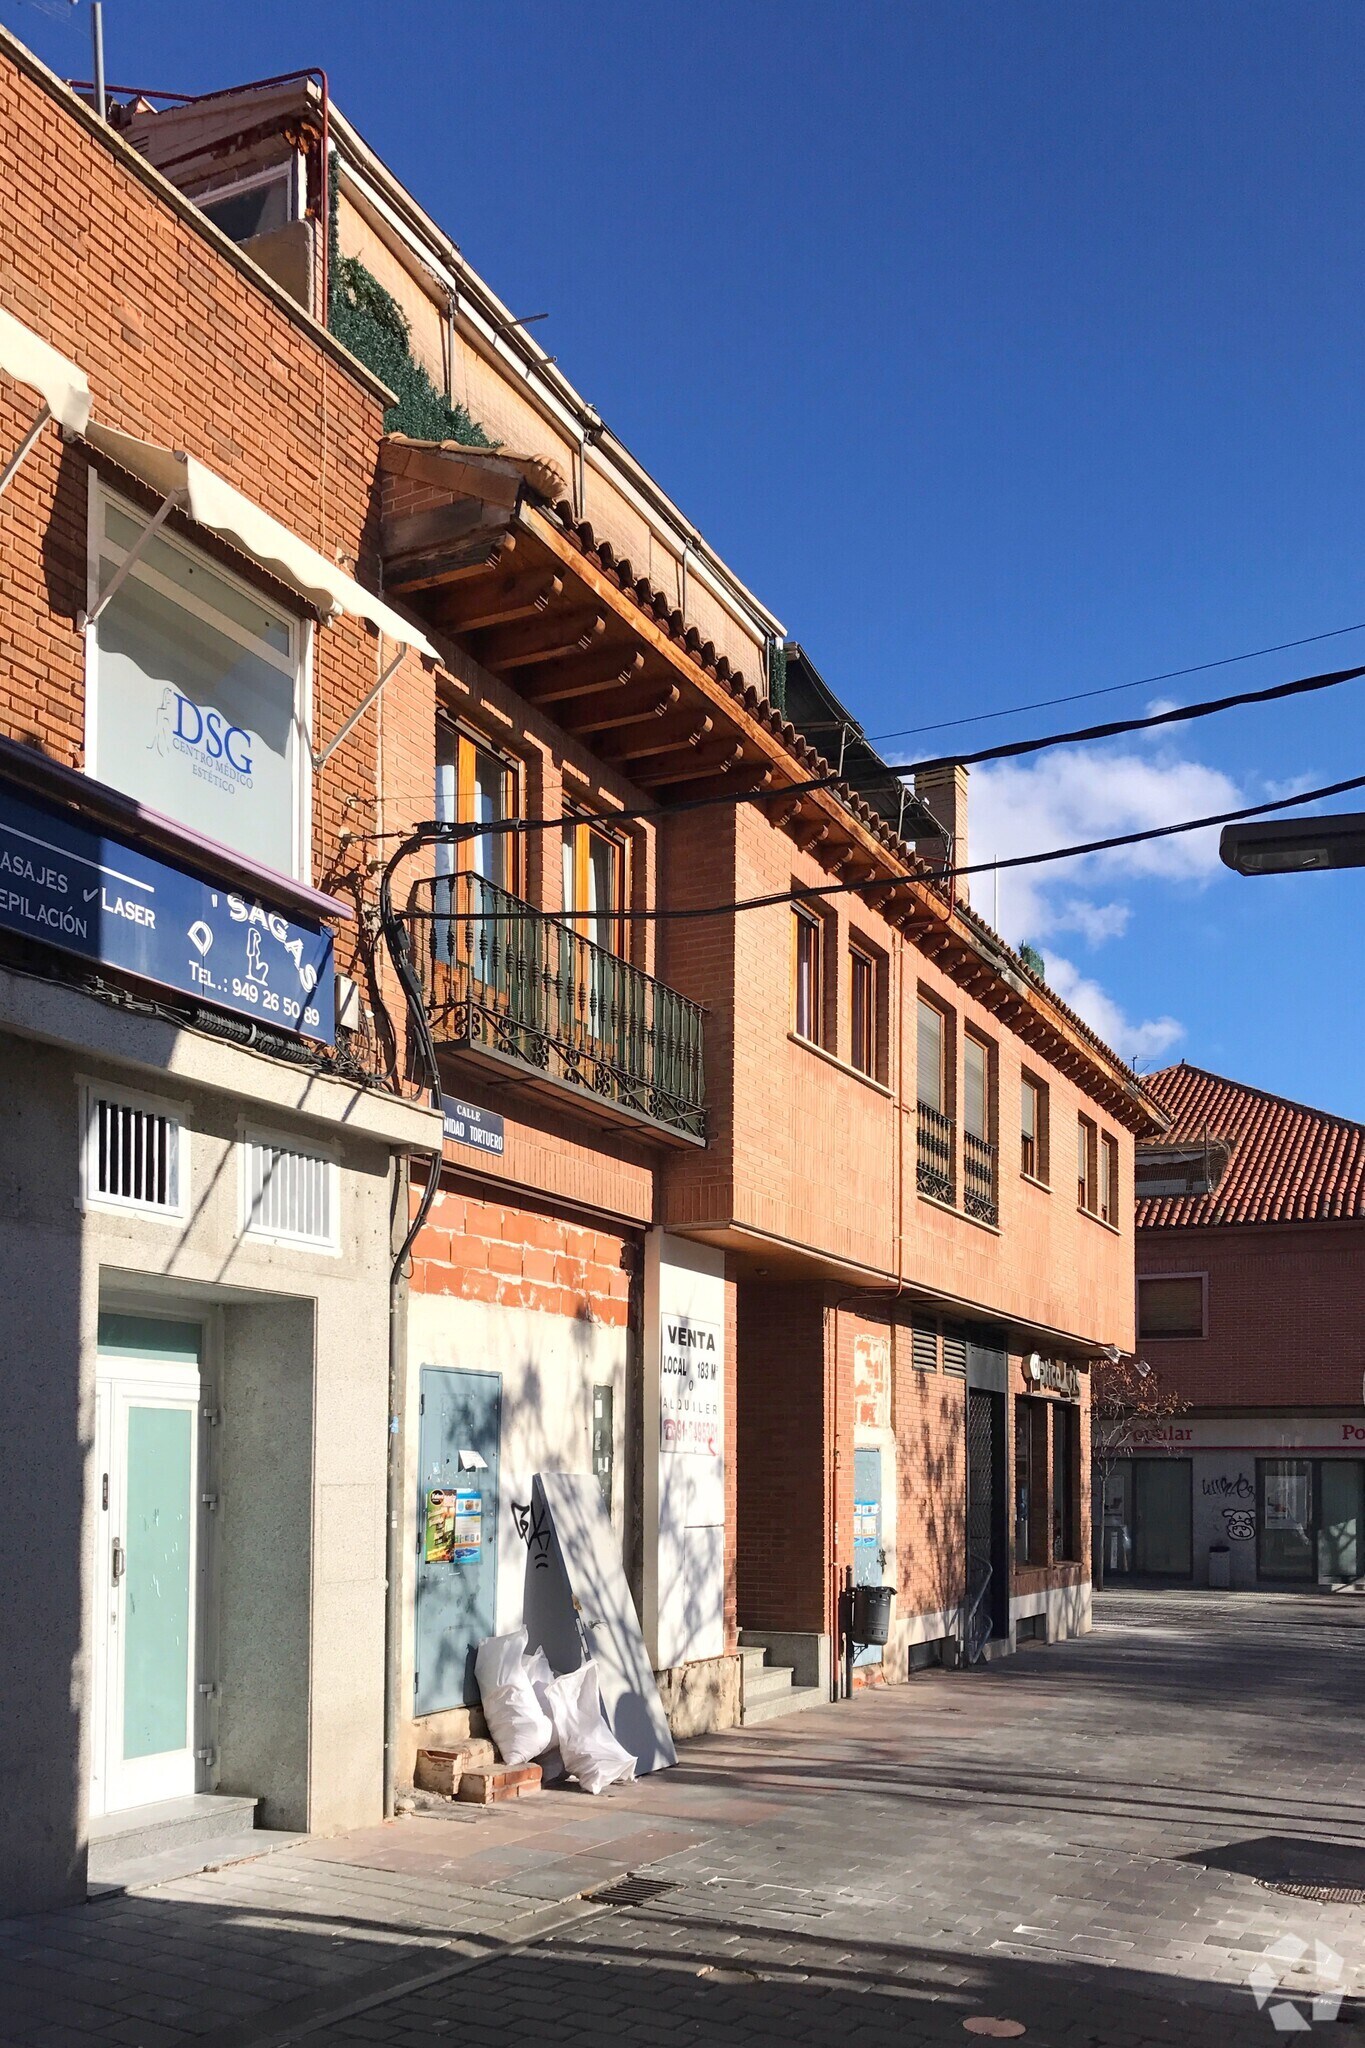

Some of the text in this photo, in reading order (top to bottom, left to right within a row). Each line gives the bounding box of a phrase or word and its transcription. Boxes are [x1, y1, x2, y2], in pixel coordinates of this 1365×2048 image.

[173, 692, 252, 774] DSG
[172, 738, 253, 789] CENTRO MÉDICO
[192, 764, 235, 794] ESTÉTICO
[101, 886, 156, 929] LASER
[232, 978, 259, 1003] 949
[262, 990, 280, 1011] 26
[283, 996, 300, 1018] 50
[303, 1006, 320, 1026] 89
[456, 1104, 481, 1122] CALLE
[469, 1125, 503, 1151] TORTUERO
[667, 1324, 715, 1351] VENTA
[663, 1354, 687, 1377] LOCAL
[697, 1361, 709, 1380] 183
[662, 1397, 718, 1415] ALQUILER
[1342, 1424, 1365, 1440] Po
